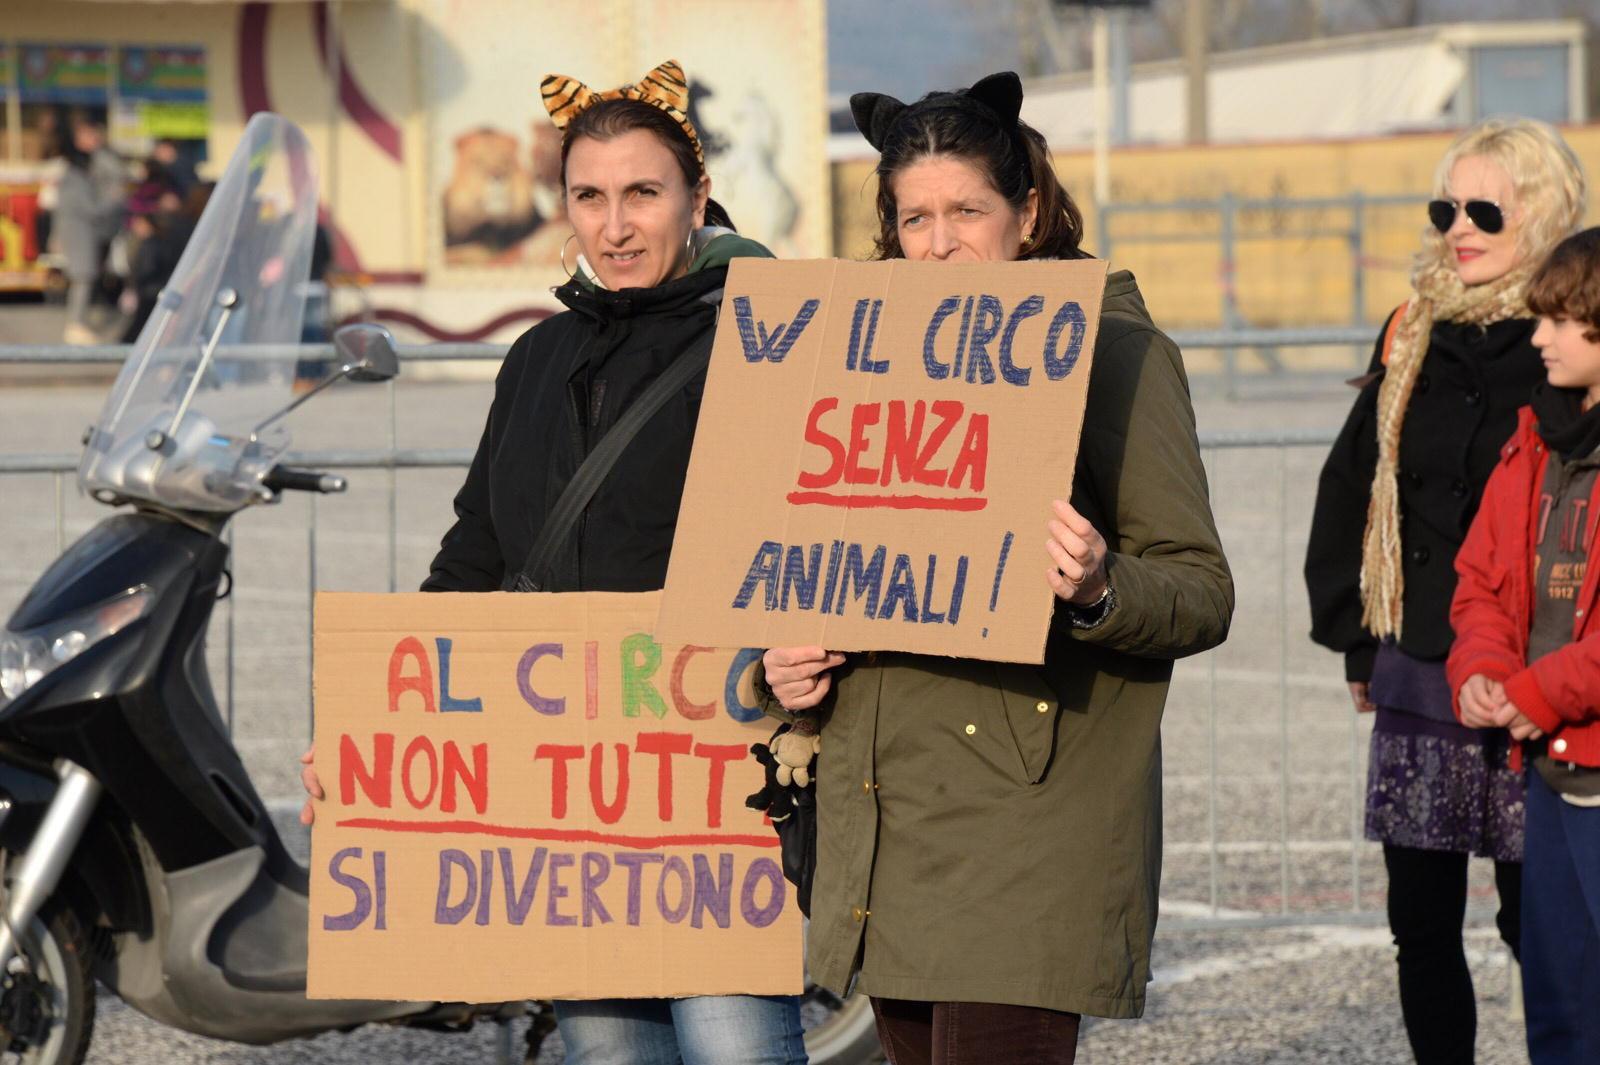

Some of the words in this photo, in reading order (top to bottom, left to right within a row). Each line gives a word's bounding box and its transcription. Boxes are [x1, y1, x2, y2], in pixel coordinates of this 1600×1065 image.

[733, 296, 821, 364] W
[846, 298, 891, 375] IL
[922, 294, 1088, 388] CIRCO
[797, 397, 990, 492] SENZA
[387, 636, 484, 714] AL
[339, 732, 489, 815] NON
[534, 732, 772, 828] TUTT
[323, 847, 387, 931] SI
[434, 847, 787, 930] DIVERTONO
